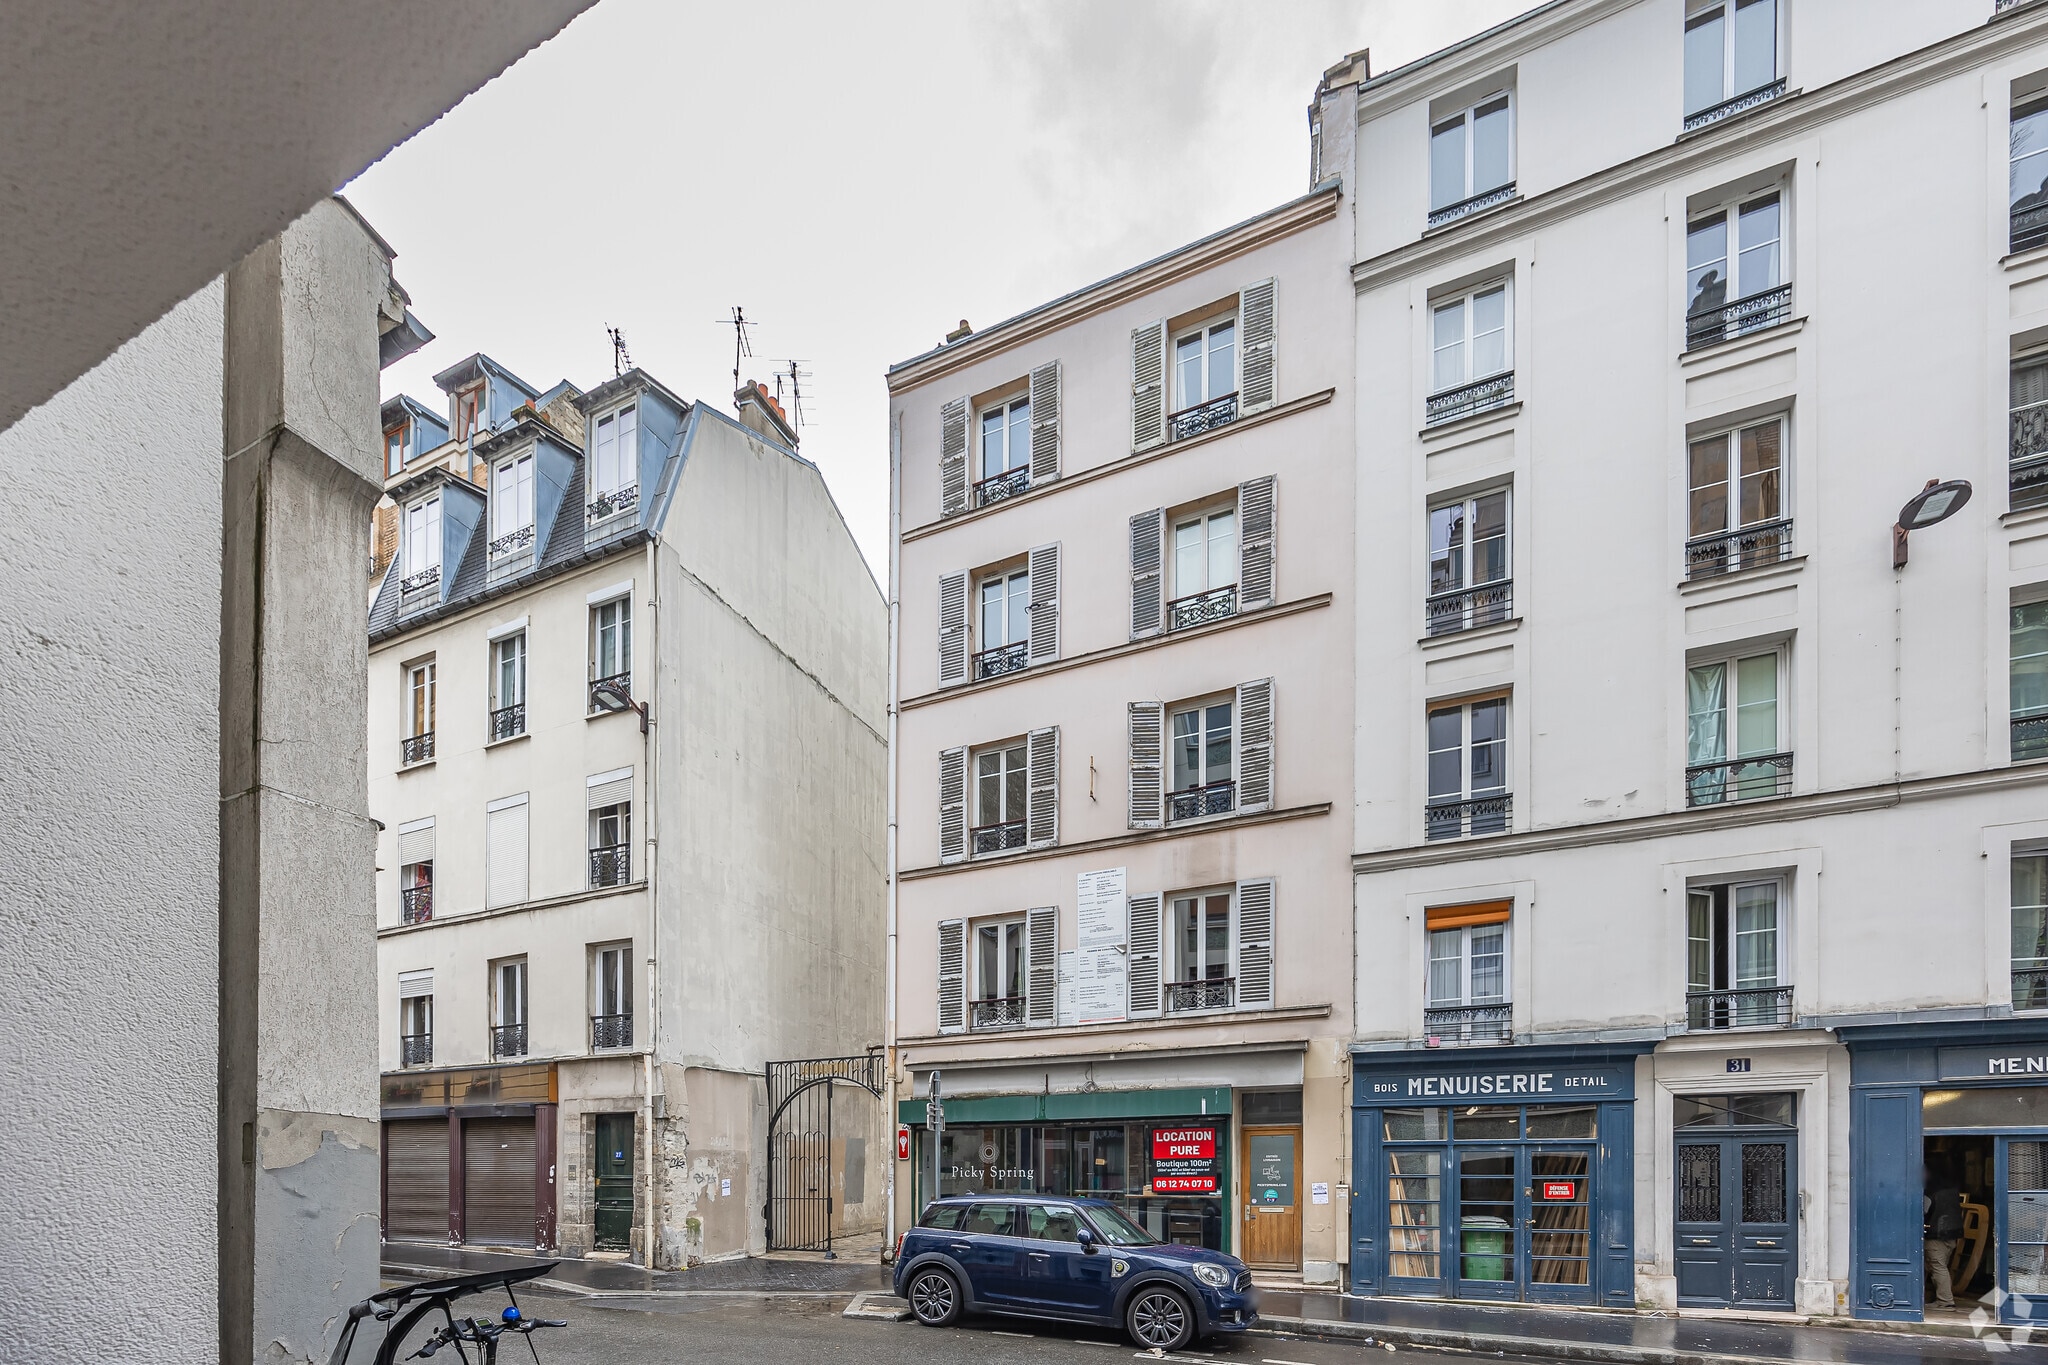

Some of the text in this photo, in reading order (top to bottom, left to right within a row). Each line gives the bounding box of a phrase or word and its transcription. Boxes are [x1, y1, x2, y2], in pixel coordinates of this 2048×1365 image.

[1730, 1059, 1746, 1072] 31
[1988, 1056, 2048, 1074] MEN
[1374, 1074, 1608, 1096] BOIS MENUISERIE DETAIL
[1155, 1131, 1212, 1142] LOCATION
[1170, 1145, 1200, 1156] PURE
[1156, 1160, 1189, 1169] Boutique
[951, 1165, 1035, 1180] Picky Spring
[1156, 1180, 1213, 1188] 06 12 74 07 10
